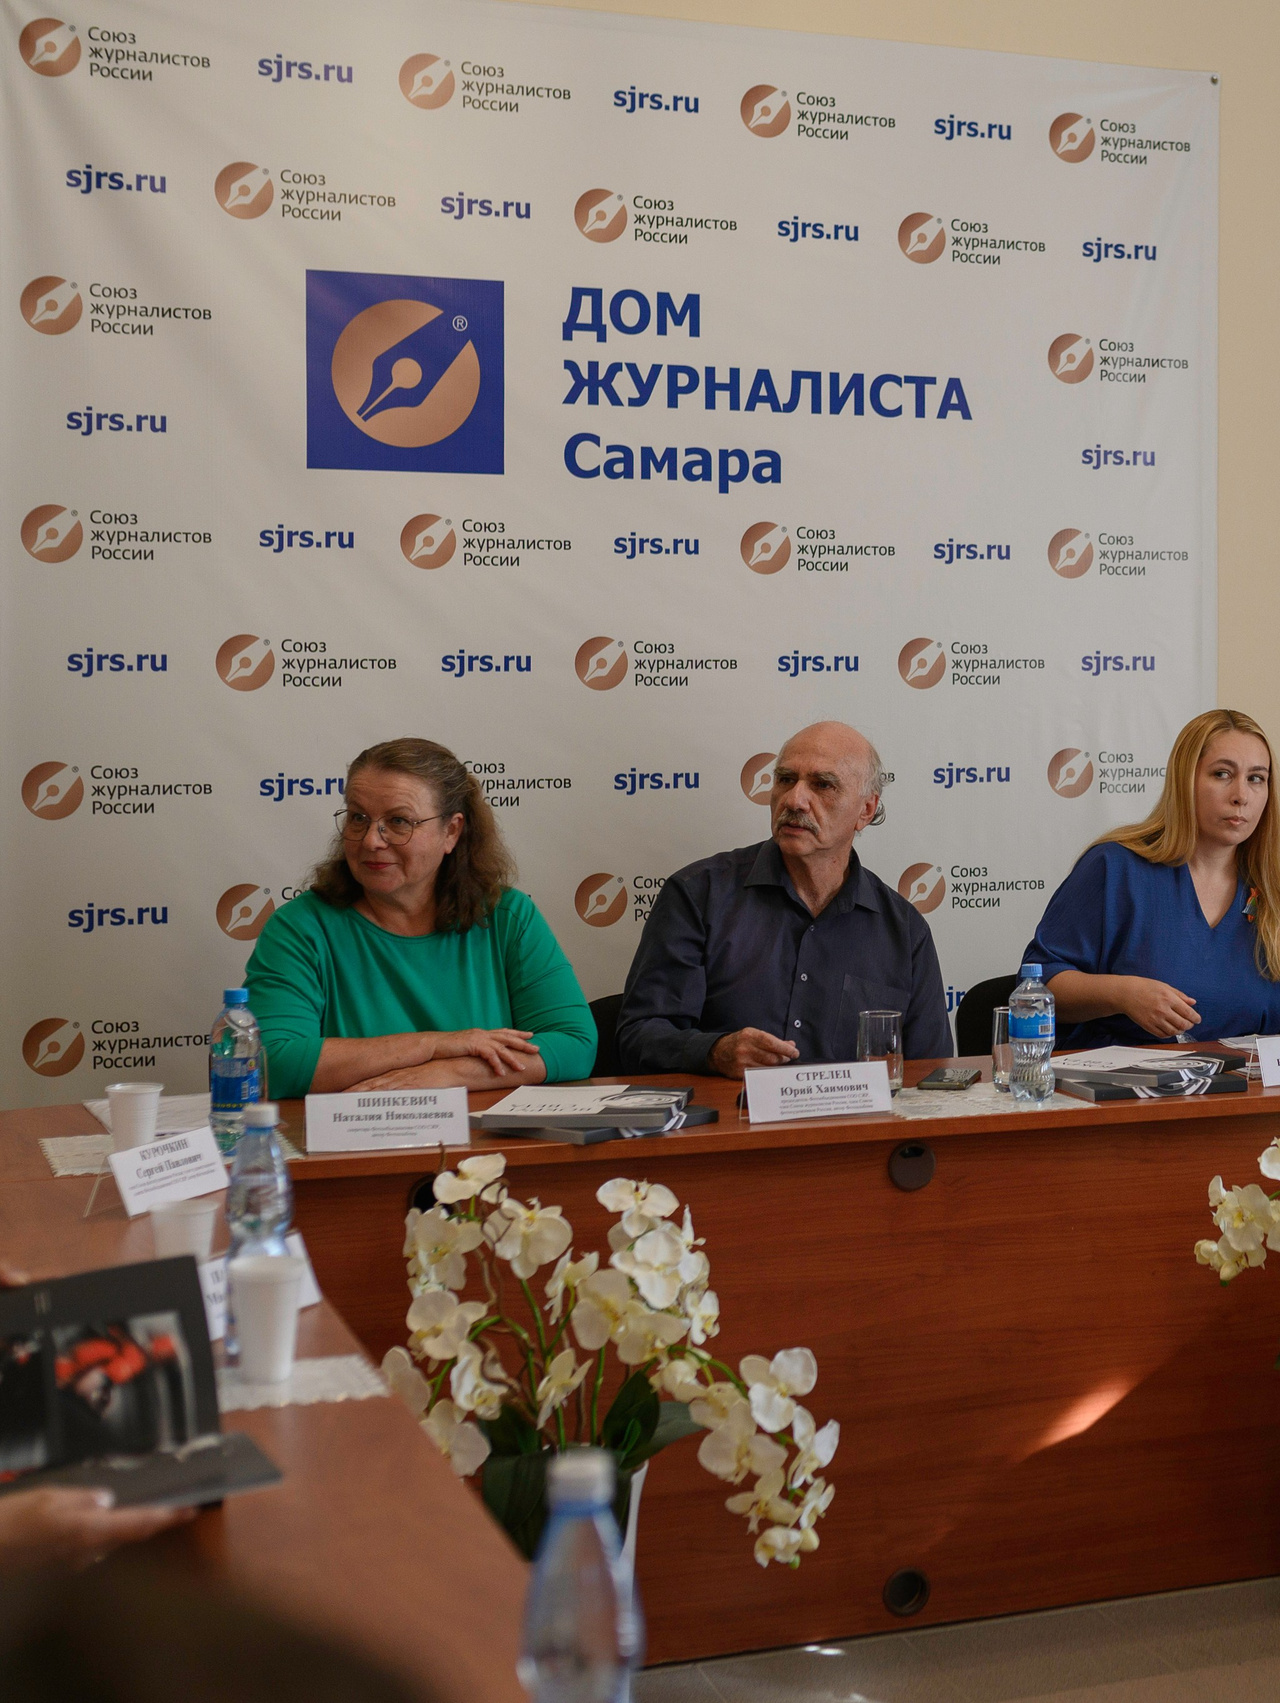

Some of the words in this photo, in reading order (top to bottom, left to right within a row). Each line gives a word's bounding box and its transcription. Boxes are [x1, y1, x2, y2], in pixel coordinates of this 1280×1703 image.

[87, 26, 137, 45] Союз
[88, 46, 211, 69] журналистов
[89, 62, 153, 82] России
[258, 54, 352, 83] sjrs.ru
[460, 61, 505, 78] Союз
[461, 80, 572, 101] журналистов
[462, 94, 519, 113] России
[614, 86, 699, 113] sjrs.ru
[796, 91, 836, 108] Союз
[796, 109, 896, 129] журналистов
[934, 114, 1011, 140] sjrs.ru
[1099, 118, 1137, 134] Союз
[797, 123, 849, 141] России
[1100, 135, 1191, 153] журналистов
[1100, 149, 1148, 166] России
[67, 164, 166, 194] sjrs.ru
[280, 169, 326, 186] Союз
[280, 188, 396, 208] журналистов
[441, 192, 530, 220] sjrs.ru
[632, 195, 675, 212] Союз
[281, 203, 342, 222] России
[633, 213, 738, 231] журналистов
[778, 216, 858, 242] sjrs.ru
[950, 218, 989, 234] Союз
[634, 227, 688, 245] России
[951, 235, 1046, 253] журналистов
[951, 249, 1001, 266] России
[1083, 237, 1156, 263] sjrs.ru
[89, 282, 138, 300] Союз
[89, 302, 213, 321] журналистов
[562, 286, 701, 343] ДОМ
[90, 318, 154, 336] России
[1098, 338, 1135, 353] Союз
[1099, 355, 1189, 370] журналистов
[1099, 368, 1147, 384] России
[562, 359, 973, 421] ЖУРНАЛИСТА
[67, 406, 166, 436] sjrs.ru
[563, 432, 782, 494] Самара
[1082, 444, 1155, 470] sjrs.ru
[89, 509, 138, 526] Союз
[461, 518, 506, 534] Союз
[90, 529, 213, 546] журналистов
[260, 524, 354, 553] sjrs.ru
[796, 526, 836, 540] Союз
[1097, 532, 1135, 546] Союз
[91, 545, 154, 561] России
[462, 537, 572, 553] журналистов
[614, 532, 699, 558] sjrs.ru
[796, 544, 896, 559] журналистов
[934, 538, 1010, 564] sjrs.ru
[463, 552, 520, 567] России
[797, 558, 849, 572] России
[1098, 549, 1189, 564] журналистов
[1099, 562, 1146, 576] России
[280, 638, 327, 654] Союз
[633, 640, 675, 655] Союз
[950, 641, 989, 655] Союз
[68, 648, 167, 677] sjrs.ru
[281, 657, 397, 674] журналистов
[442, 649, 531, 677] sjrs.ru
[633, 658, 738, 674] журналистов
[778, 650, 858, 676] sjrs.ru
[951, 658, 1046, 673] журналистов
[1082, 650, 1155, 676] sjrs.ru
[282, 672, 342, 688] России
[634, 673, 689, 687] России
[951, 672, 1001, 686] России
[1097, 750, 1134, 764] Союз
[90, 764, 139, 780] Союз
[934, 762, 1010, 788] sjrs.ru
[1098, 767, 1166, 782] журналис
[481, 778, 572, 793] рналистов
[614, 768, 699, 795] sjrs.ru
[1099, 781, 1146, 794] России
[90, 783, 213, 801] журналистов
[92, 800, 155, 815] России
[950, 864, 989, 879] Союз
[633, 876, 666, 889] Сою
[950, 879, 1046, 897] журналистов
[951, 896, 1001, 909] России
[68, 903, 168, 933] sjrs.ru
[90, 1019, 140, 1035] Союз
[92, 1034, 211, 1054] журналистов
[92, 1055, 156, 1070] России
[796, 1069, 852, 1082] СТРЕЛЕЦ
[780, 1085, 813, 1097] Юрий
[816, 1083, 869, 1094] Хаимович
[357, 1095, 438, 1108] ШИНКЕВИЧ
[332, 1112, 382, 1123] Наталия
[385, 1110, 454, 1121] Николаевна
[139, 1138, 189, 1161] КУРОЧКИН
